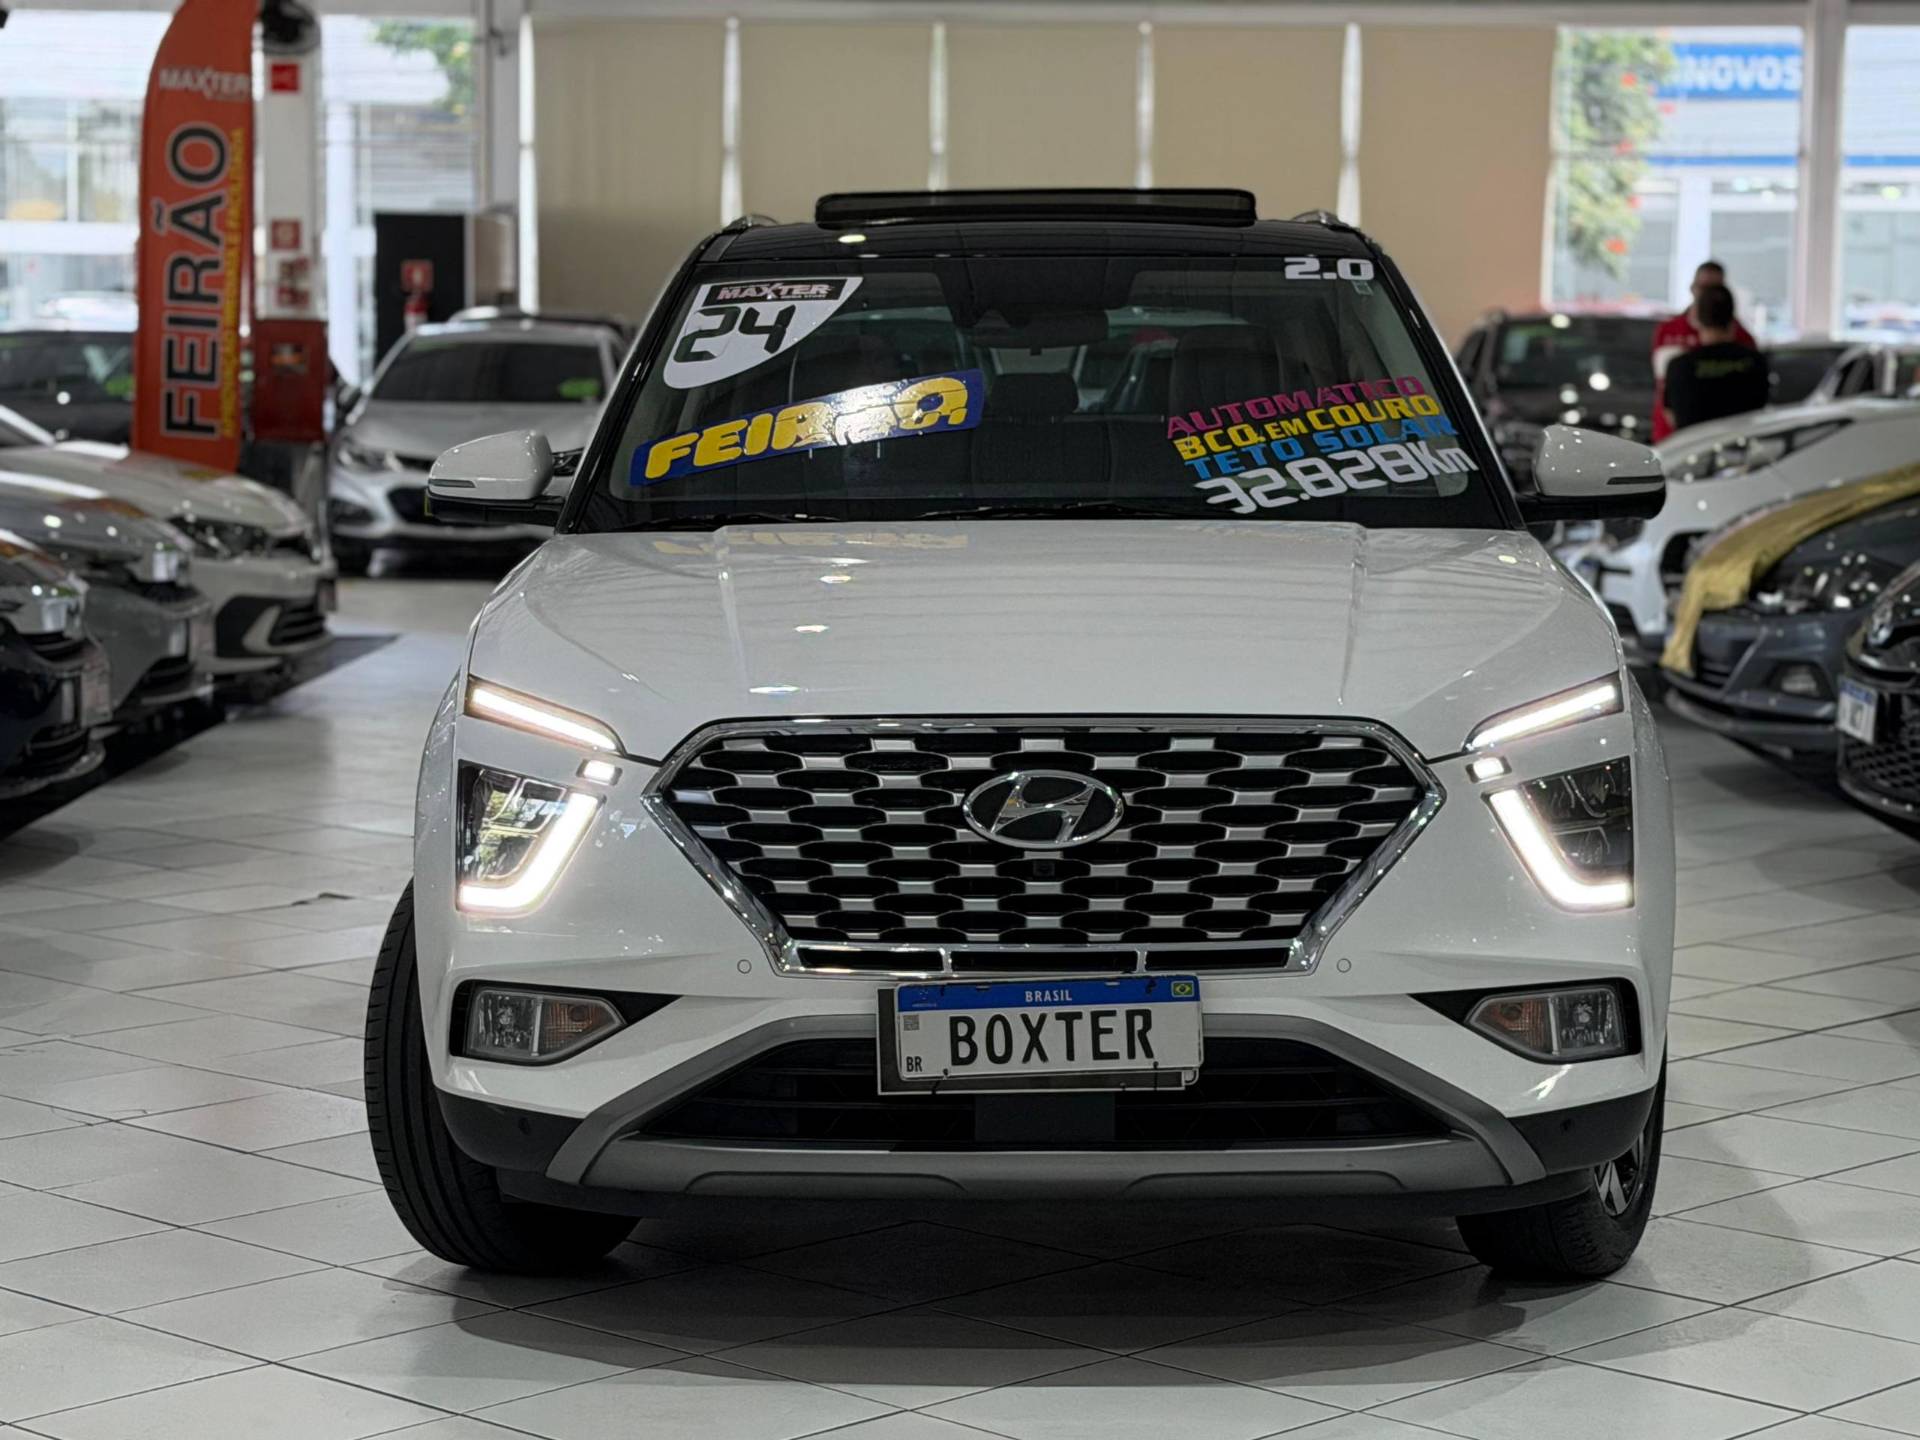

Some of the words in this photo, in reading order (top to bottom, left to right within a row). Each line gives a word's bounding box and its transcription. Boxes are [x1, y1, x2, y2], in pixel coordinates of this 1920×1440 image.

[159, 66, 249, 98] MAXTER
[152, 122, 230, 439] FEIRÃO
[1284, 257, 1375, 281] 2.0
[717, 282, 834, 300] MAXTER
[673, 304, 796, 363] 24
[1264, 417, 1308, 441] EM
[1306, 394, 1440, 431] COURO
[1184, 437, 1305, 481] TETO
[1312, 415, 1459, 453] SOLAR
[1024, 990, 1073, 1003] BRASIL
[948, 1008, 1154, 1067] BOXTER
[905, 1056, 922, 1073] BR
